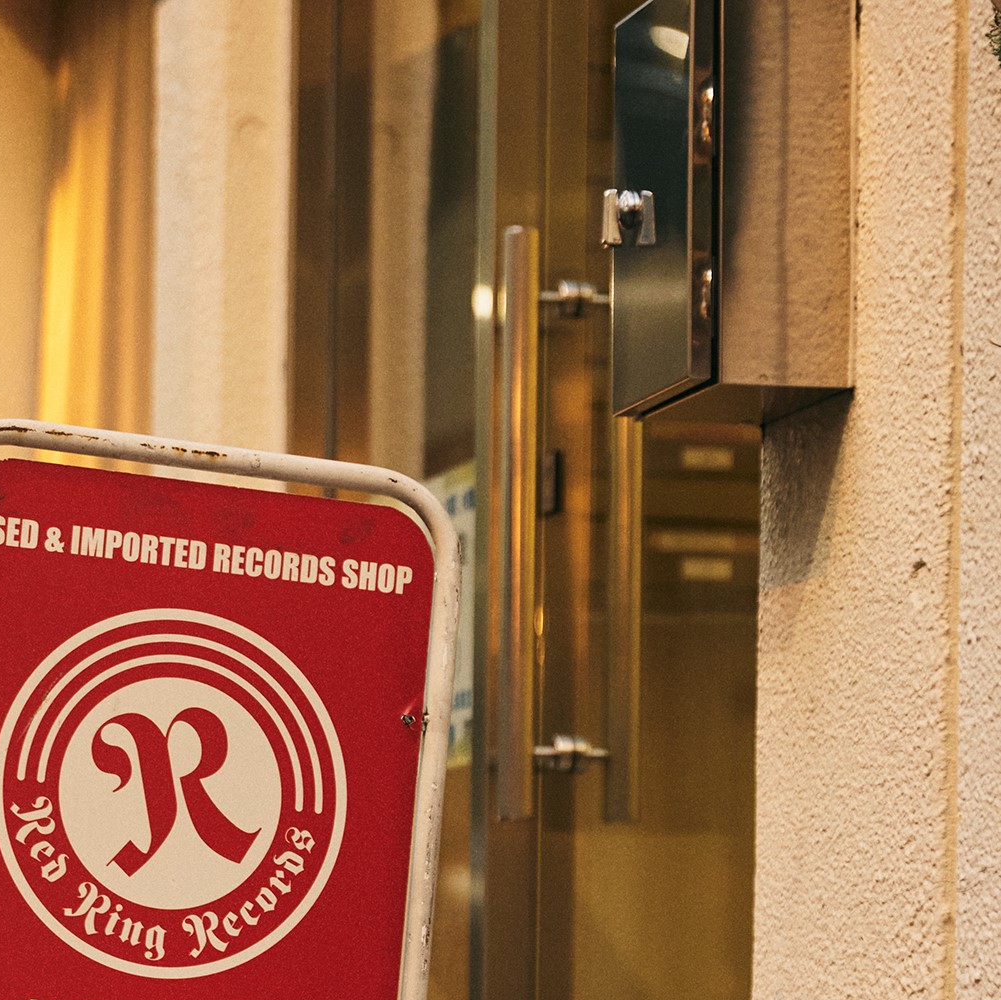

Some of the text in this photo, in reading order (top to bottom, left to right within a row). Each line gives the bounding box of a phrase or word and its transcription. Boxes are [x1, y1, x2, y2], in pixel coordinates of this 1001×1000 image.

[43, 526, 65, 553] &
[70, 524, 208, 570] IMPORTED
[212, 542, 336, 587] RECORDS
[341, 558, 413, 595] SHOP
[9, 795, 316, 961] Red Ring Records
